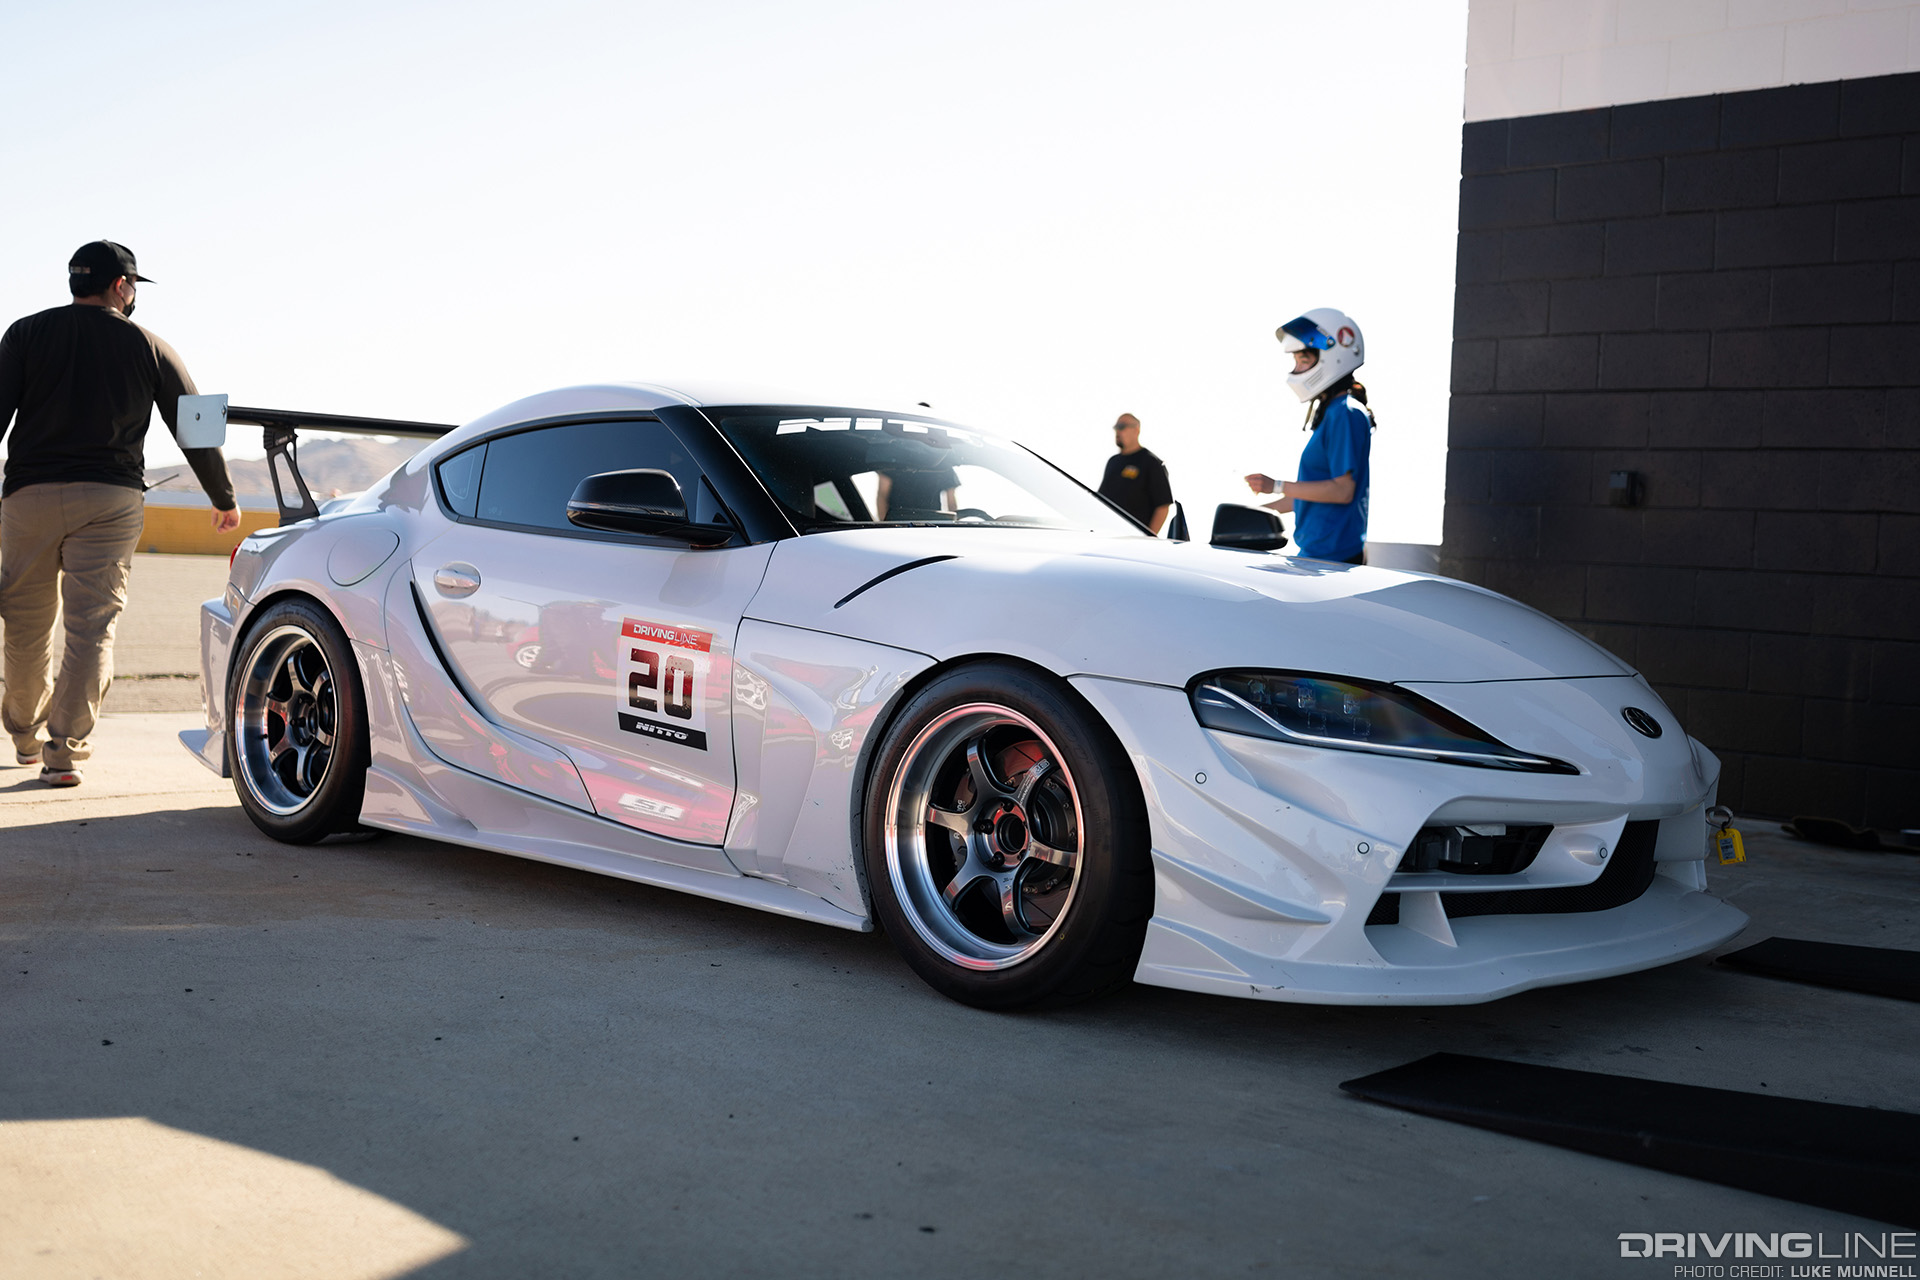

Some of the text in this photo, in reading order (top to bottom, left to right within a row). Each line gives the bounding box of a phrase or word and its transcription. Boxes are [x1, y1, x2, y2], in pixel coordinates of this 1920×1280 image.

[633, 624, 698, 645] DRIVINGLINE
[628, 647, 694, 720] 20
[635, 721, 688, 740] NITTO
